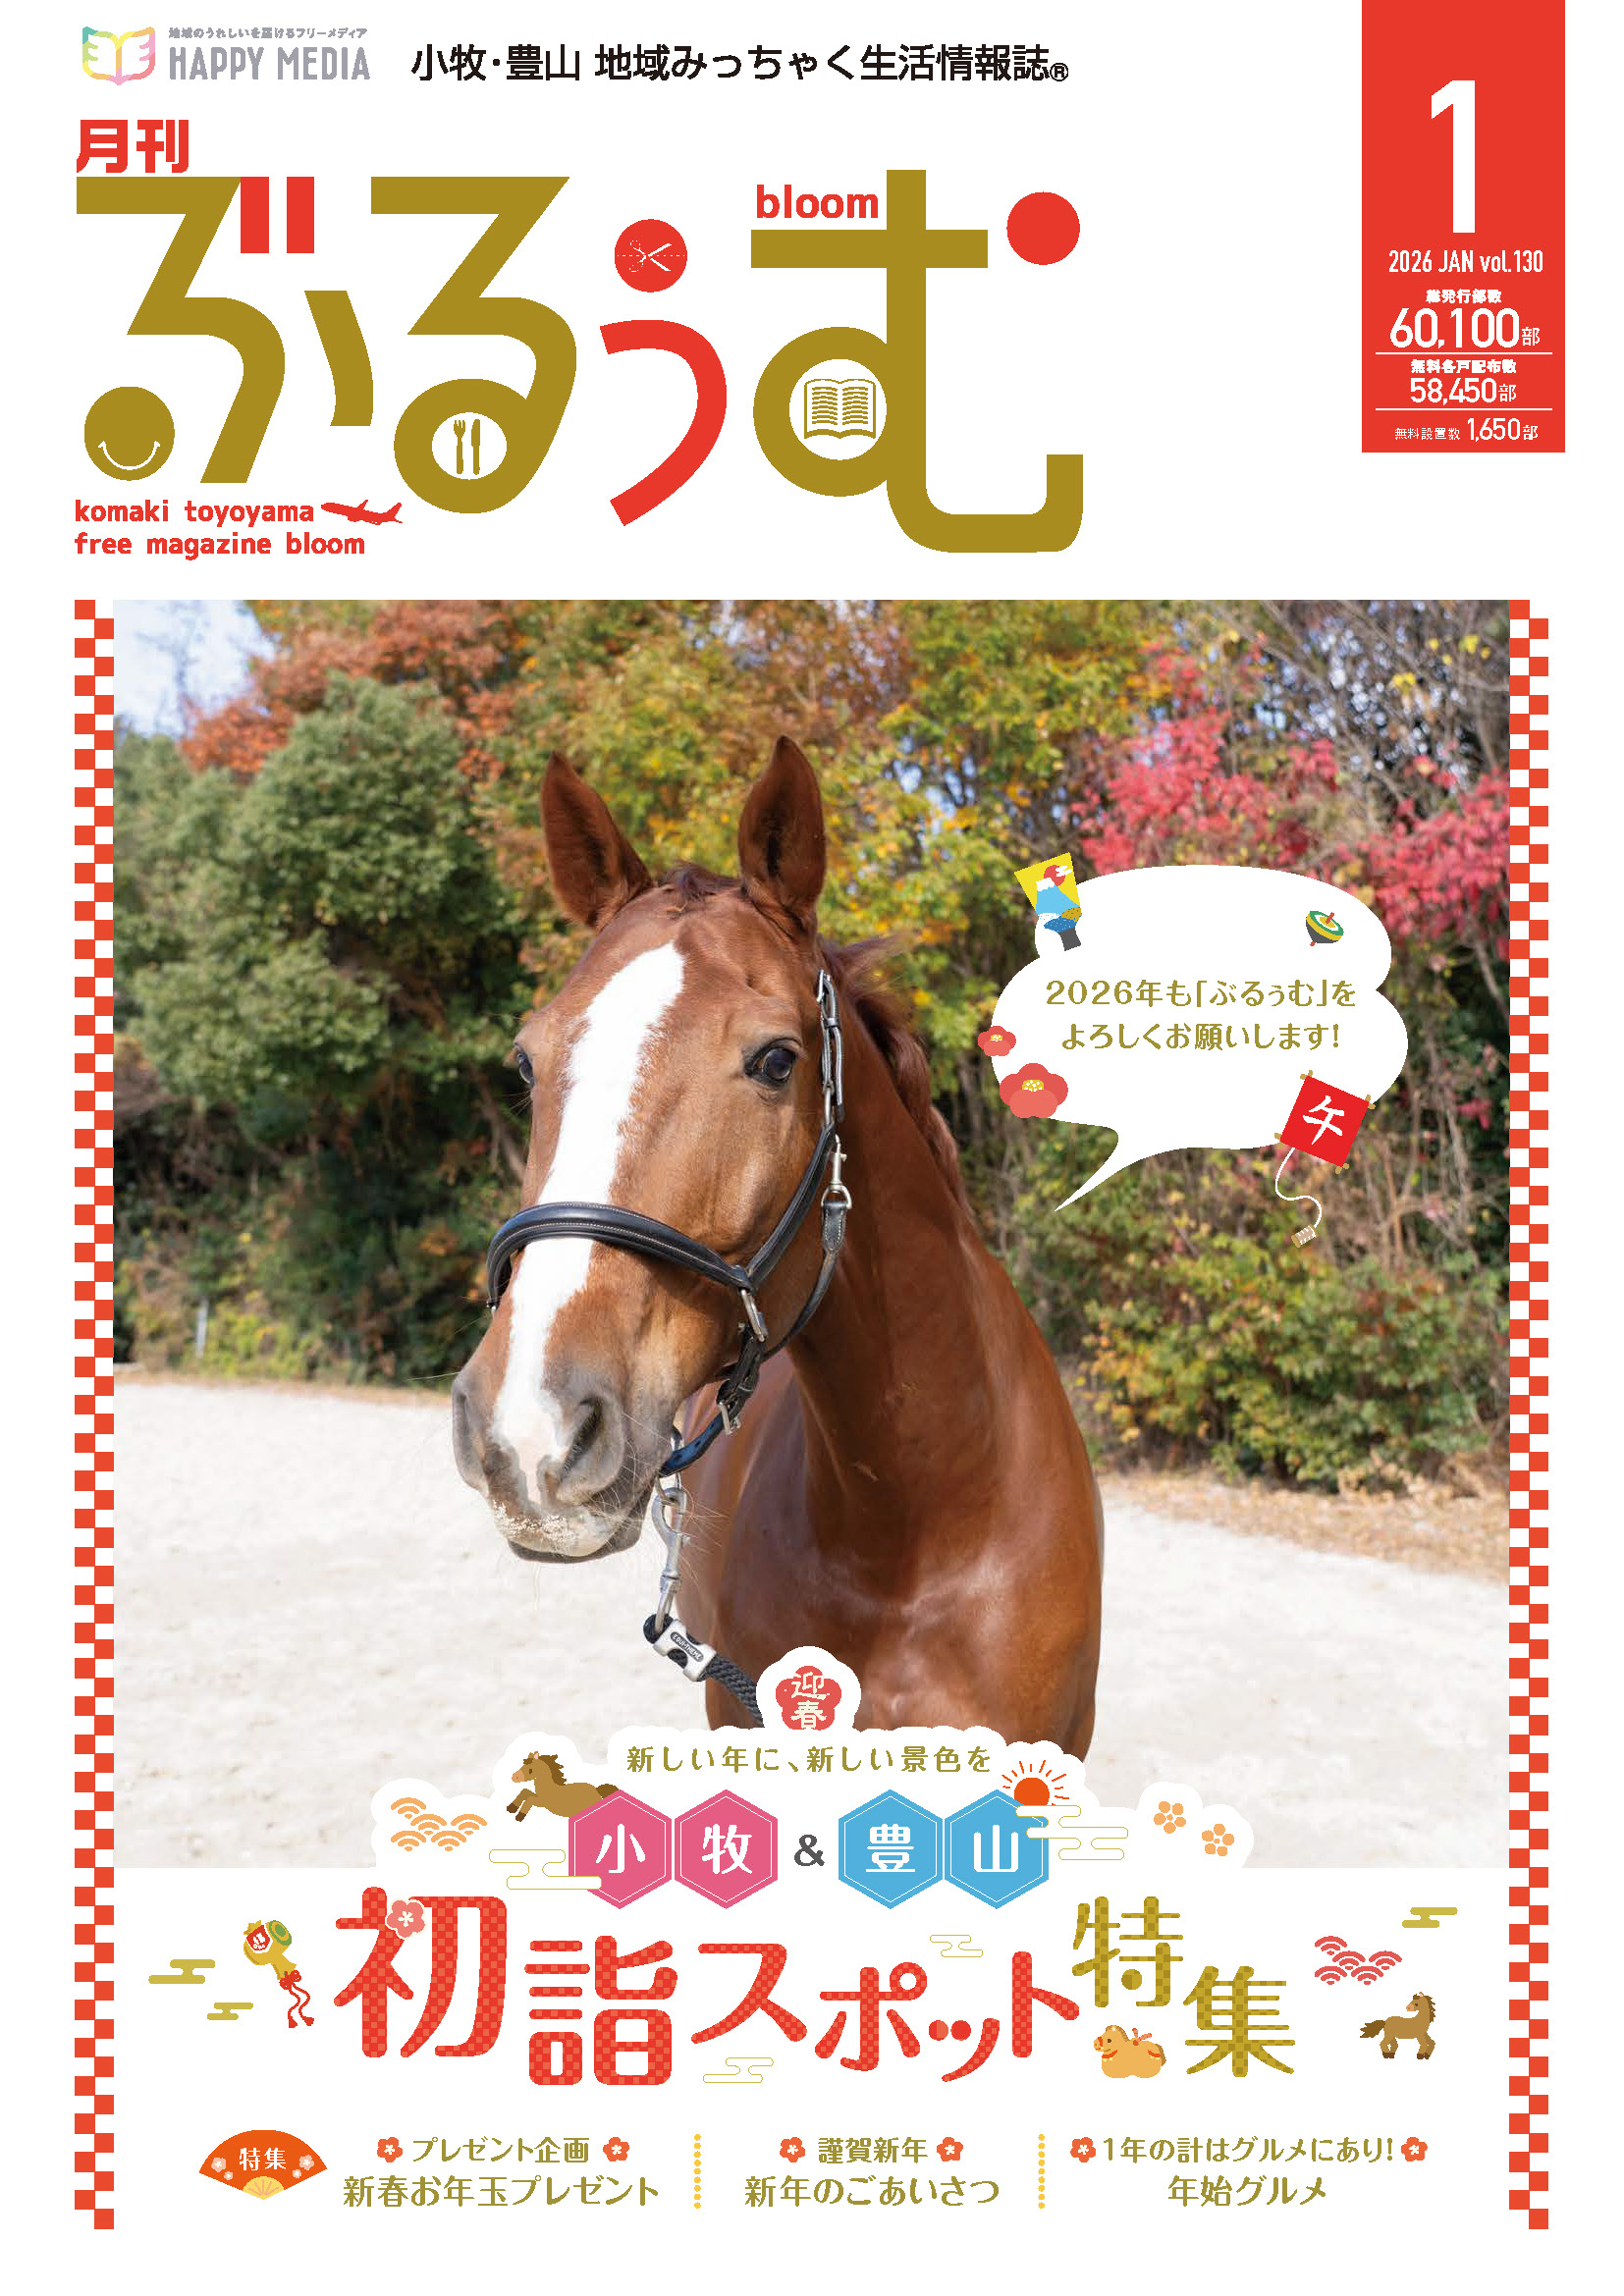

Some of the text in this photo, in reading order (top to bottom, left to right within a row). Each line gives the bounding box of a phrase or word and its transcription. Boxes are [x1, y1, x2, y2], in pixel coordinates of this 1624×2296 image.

[170, 47, 370, 80] HAPPY MEDIA
[411, 44, 579, 80] 小牧・豊山
[77, 120, 189, 173] 月刊
[1432, 80, 1475, 233] 1
[757, 185, 878, 218] bloom
[1389, 250, 1543, 272] 2026 JAN vol.130
[1390, 308, 1540, 348] 60,100部
[1411, 359, 1516, 373] 無料各戸配布数
[1411, 378, 1516, 405] 58,450部
[1395, 418, 1538, 442] 無料設置数 1,650部
[76, 500, 313, 527] komaki toyoyama
[75, 532, 364, 561] free magazine bloom
[1062, 1023, 1338, 1050] よろしくお願いします!
[1302, 1095, 1344, 1145] 午
[789, 1671, 831, 1730] 迎春
[627, 1746, 990, 1773] 新しい年に、新しい景色を
[595, 1822, 1021, 1876] 小牧 & 豊山
[240, 2147, 287, 2172] 特集
[413, 2136, 589, 2163] プレゼント企画
[818, 2137, 928, 2163] 謹賀新年
[1104, 2136, 1392, 2163] 1年の計はグルメにあり!
[344, 2175, 658, 2207] 新春お年玉プレゼント
[745, 2175, 999, 2207] 新年のごあいさつ
[1168, 2175, 1326, 2207] 年始グルメ
